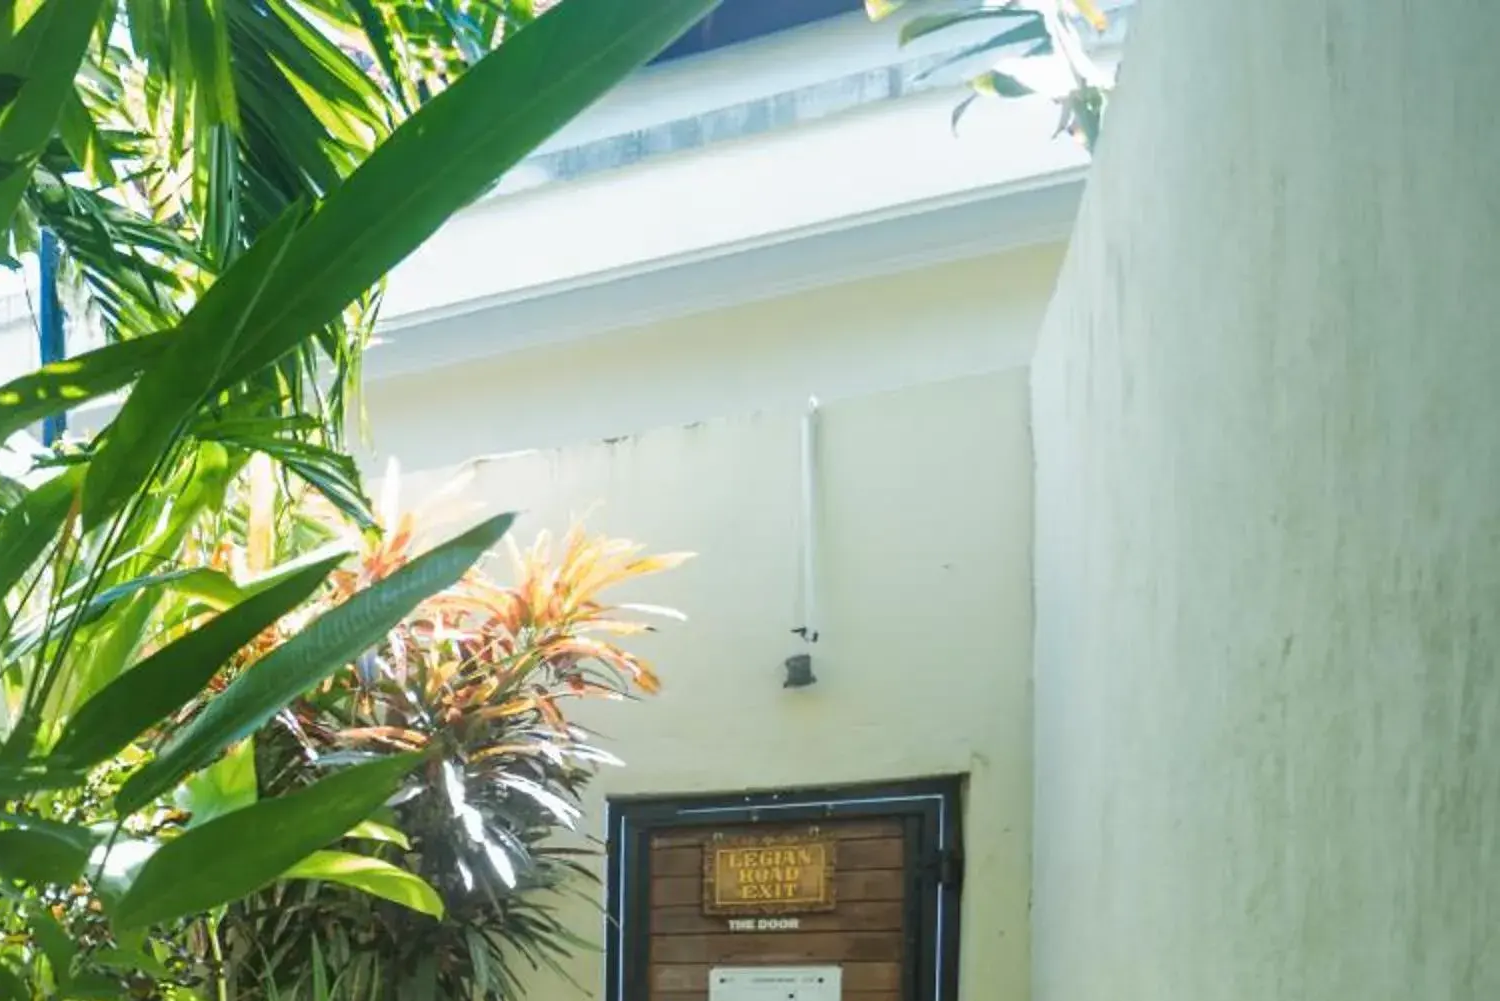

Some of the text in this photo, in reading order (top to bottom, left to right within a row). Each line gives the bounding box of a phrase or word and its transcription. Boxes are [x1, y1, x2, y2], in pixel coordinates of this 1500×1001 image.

[729, 849, 812, 868] LEGIAN
[738, 866, 800, 883] ROAD
[741, 883, 798, 899] EXIT
[728, 918, 800, 930] THE DOOR
